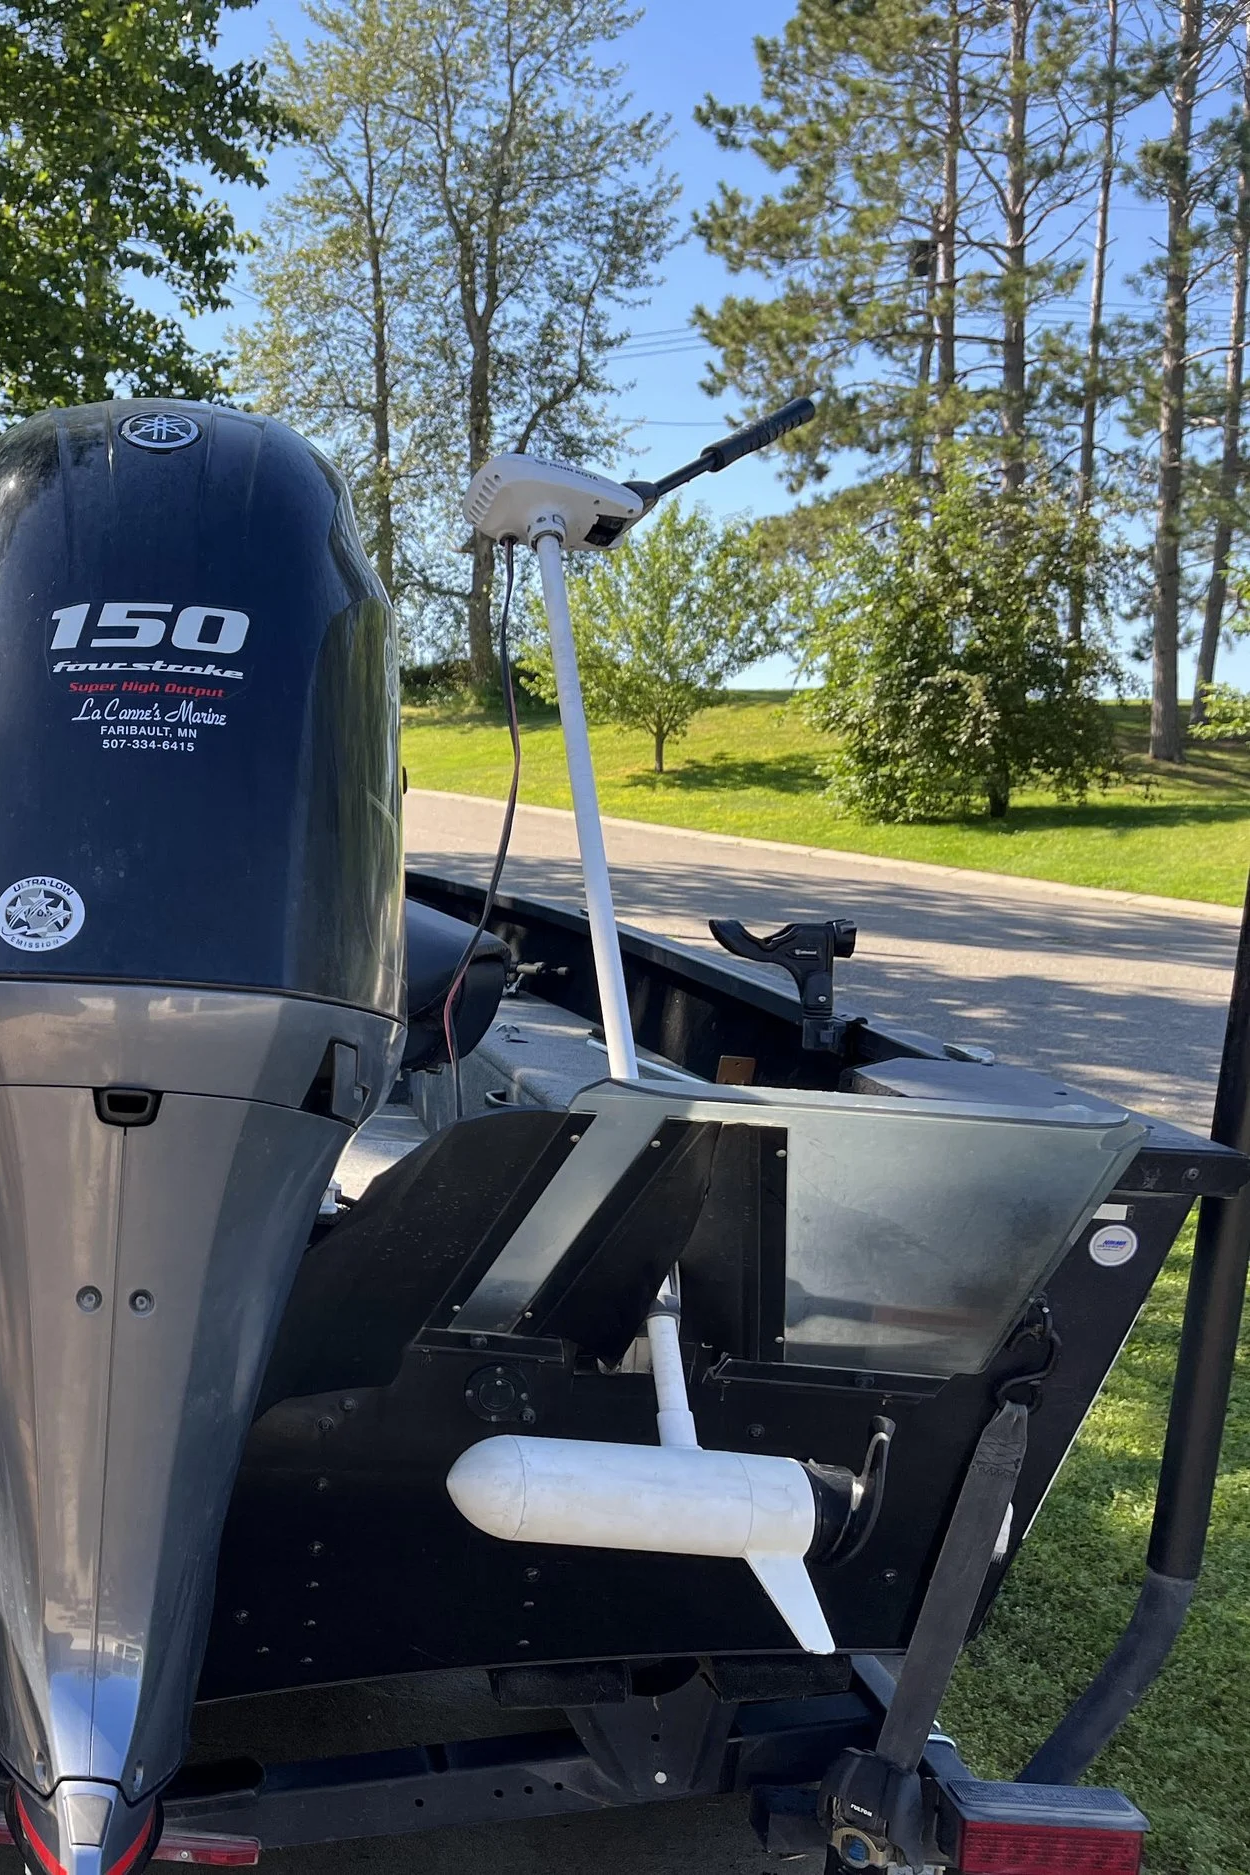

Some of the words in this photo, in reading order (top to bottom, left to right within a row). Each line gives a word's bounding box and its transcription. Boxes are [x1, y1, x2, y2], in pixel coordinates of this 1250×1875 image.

[50, 602, 250, 654] 150
[68, 681, 117, 694] Super
[121, 681, 160, 694] High
[164, 683, 226, 698] Output
[164, 700, 227, 726] Marine
[100, 726, 173, 738] FARIBAULT,
[177, 728, 197, 739] MN
[102, 739, 195, 752] 507-334-6415
[10, 936, 60, 949] EMISSION
